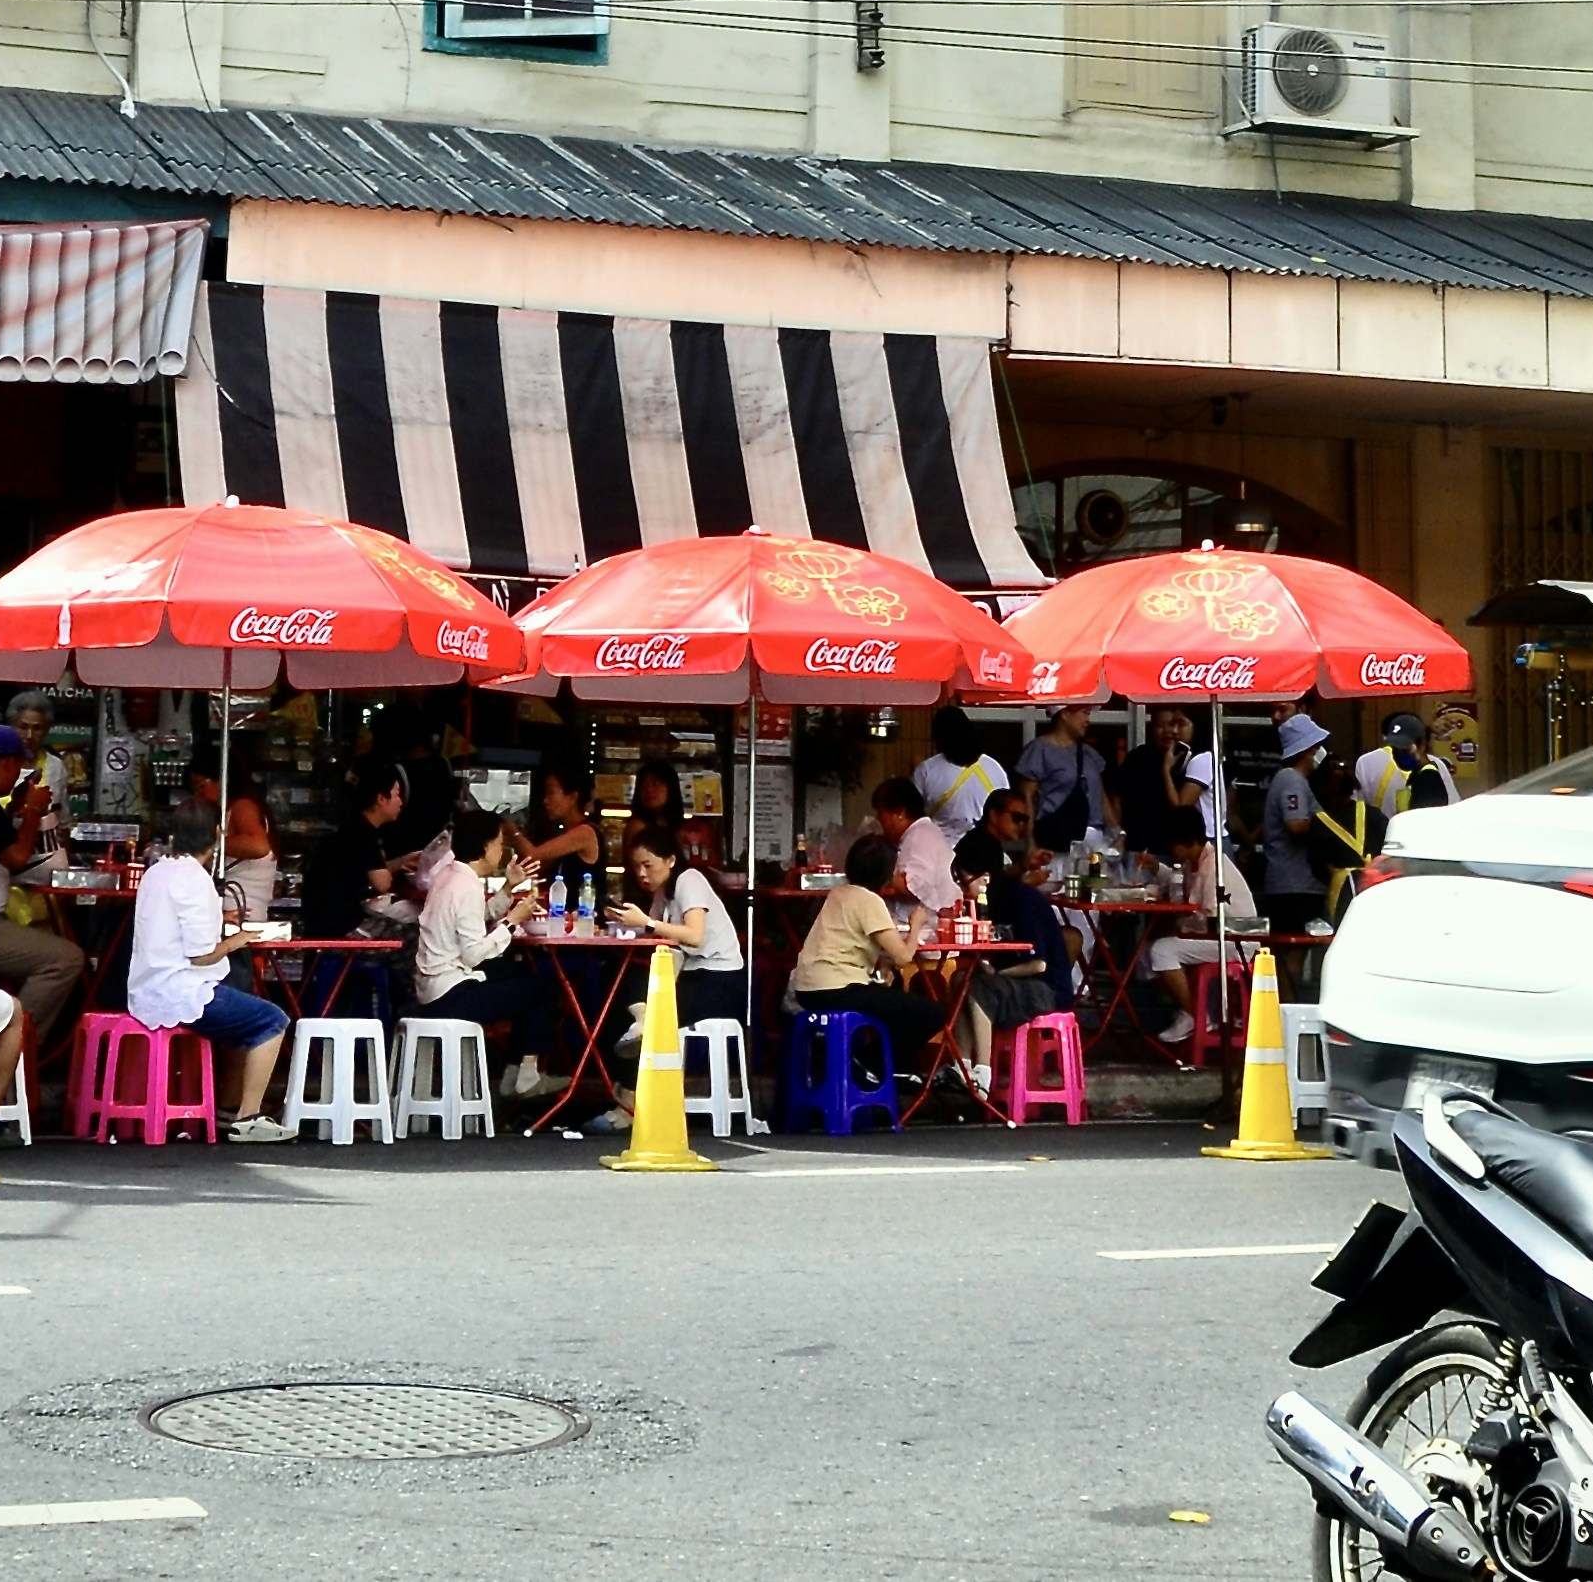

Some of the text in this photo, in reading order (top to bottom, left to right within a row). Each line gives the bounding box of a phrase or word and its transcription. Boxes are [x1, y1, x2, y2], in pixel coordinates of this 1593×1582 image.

[229, 606, 339, 645] Coca-Cola
[436, 620, 490, 661] Coca-Cola
[595, 634, 691, 670] Coca-Cola
[805, 637, 902, 674] Coca-Cola
[1360, 653, 1427, 686] Coca-Cola
[1160, 656, 1260, 690] Coca-Cola
